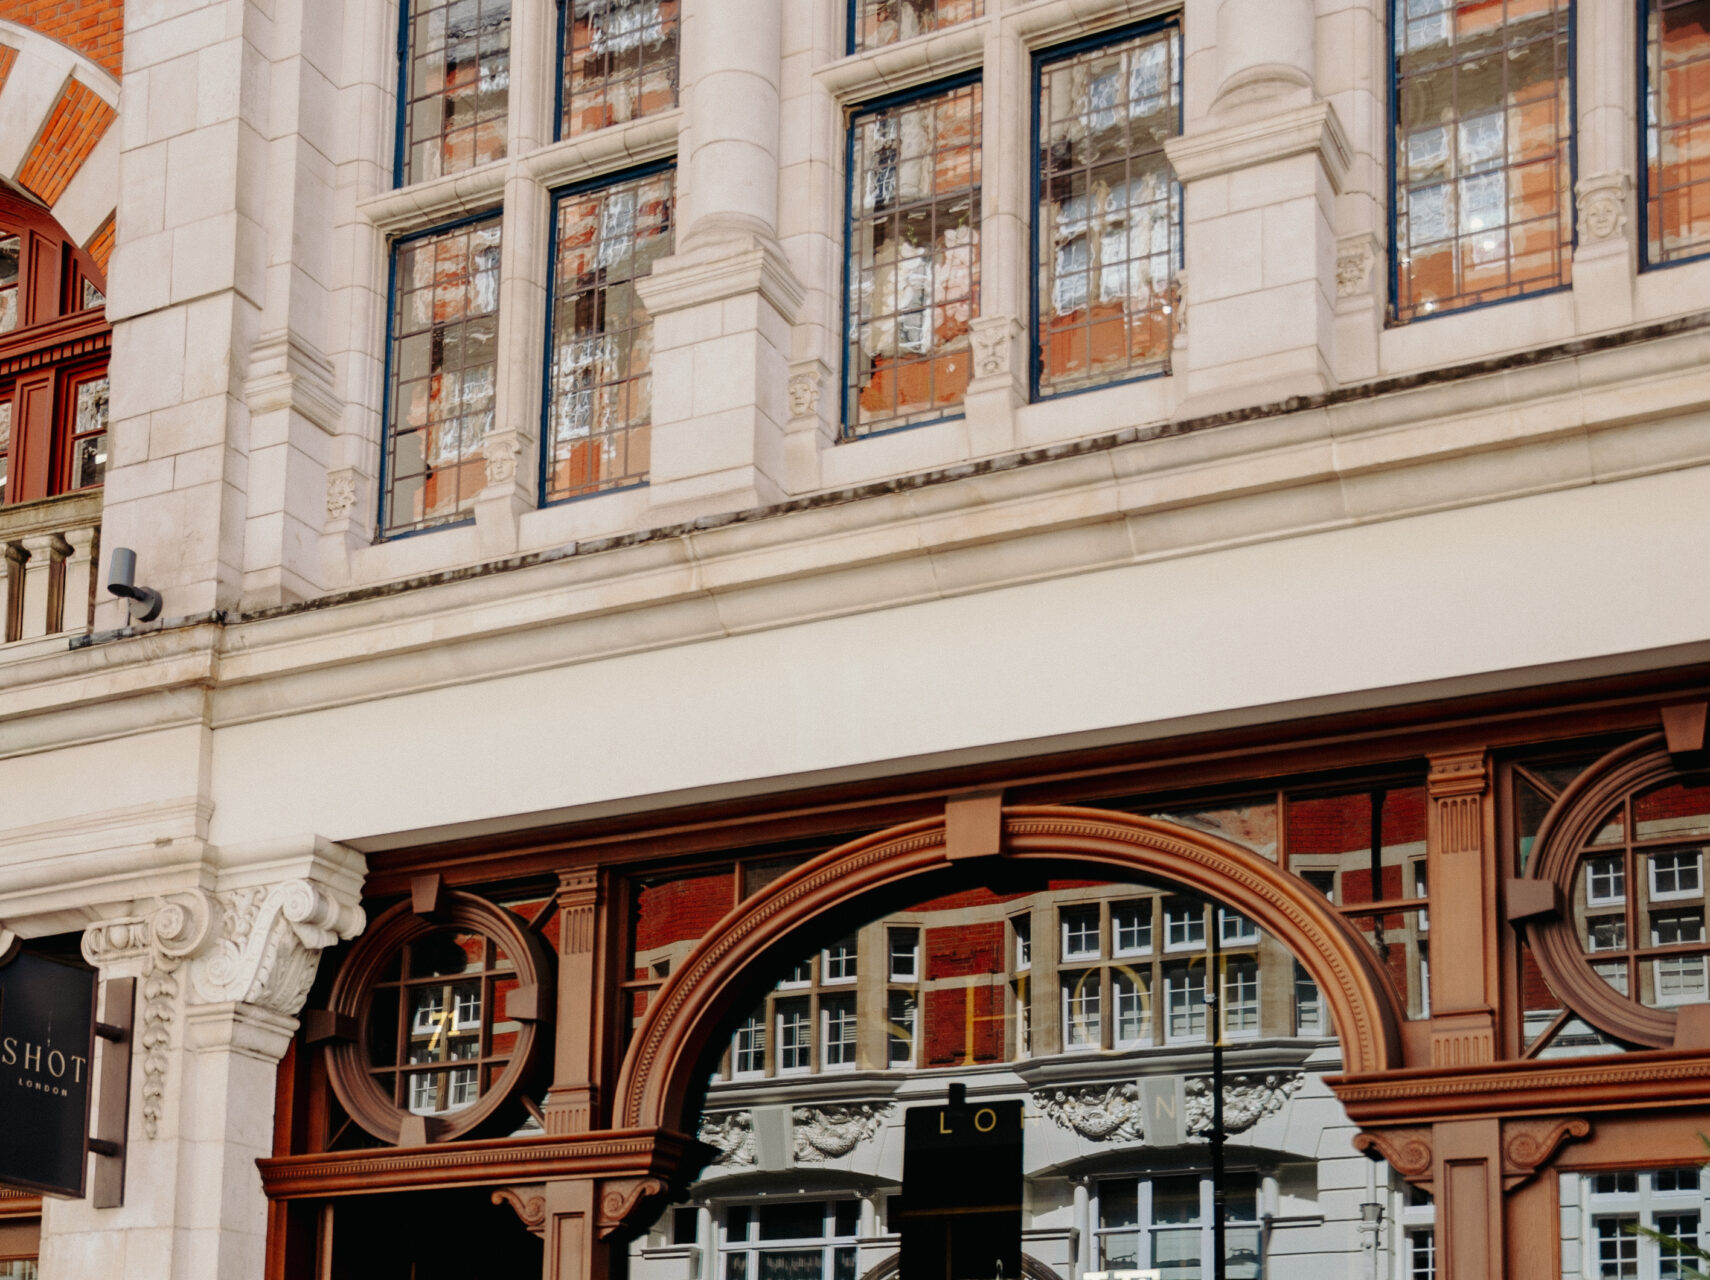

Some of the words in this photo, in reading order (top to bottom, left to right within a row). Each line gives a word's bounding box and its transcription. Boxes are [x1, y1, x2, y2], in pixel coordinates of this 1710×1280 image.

[428, 1010, 461, 1051] 71
[2, 1037, 86, 1083] SHOT
[19, 1077, 67, 1096] LONDON
